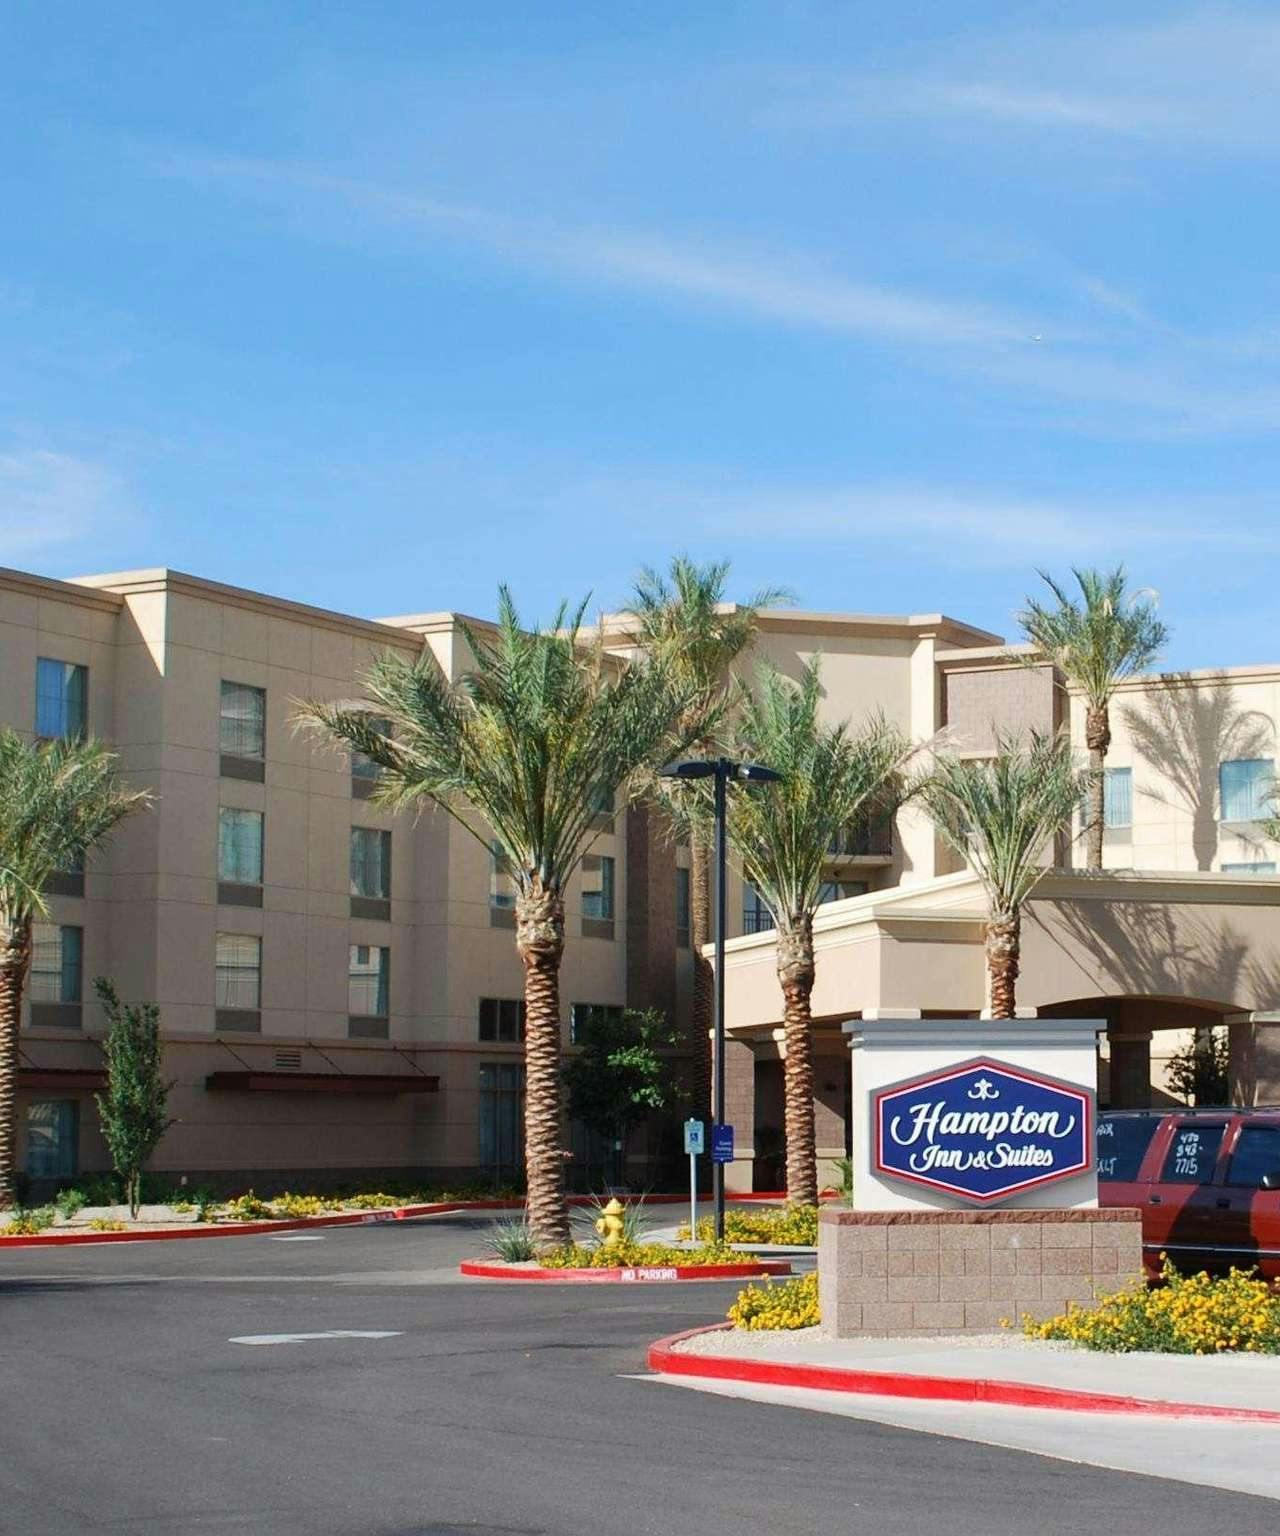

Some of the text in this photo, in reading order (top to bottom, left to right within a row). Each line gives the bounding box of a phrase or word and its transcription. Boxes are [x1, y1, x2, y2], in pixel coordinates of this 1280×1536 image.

[890, 1101, 1075, 1145] Hampton
[909, 1143, 1054, 1172] Inn & Suites
[1175, 1158, 1198, 1175] 7715
[621, 1268, 678, 1281] NO PARKING
